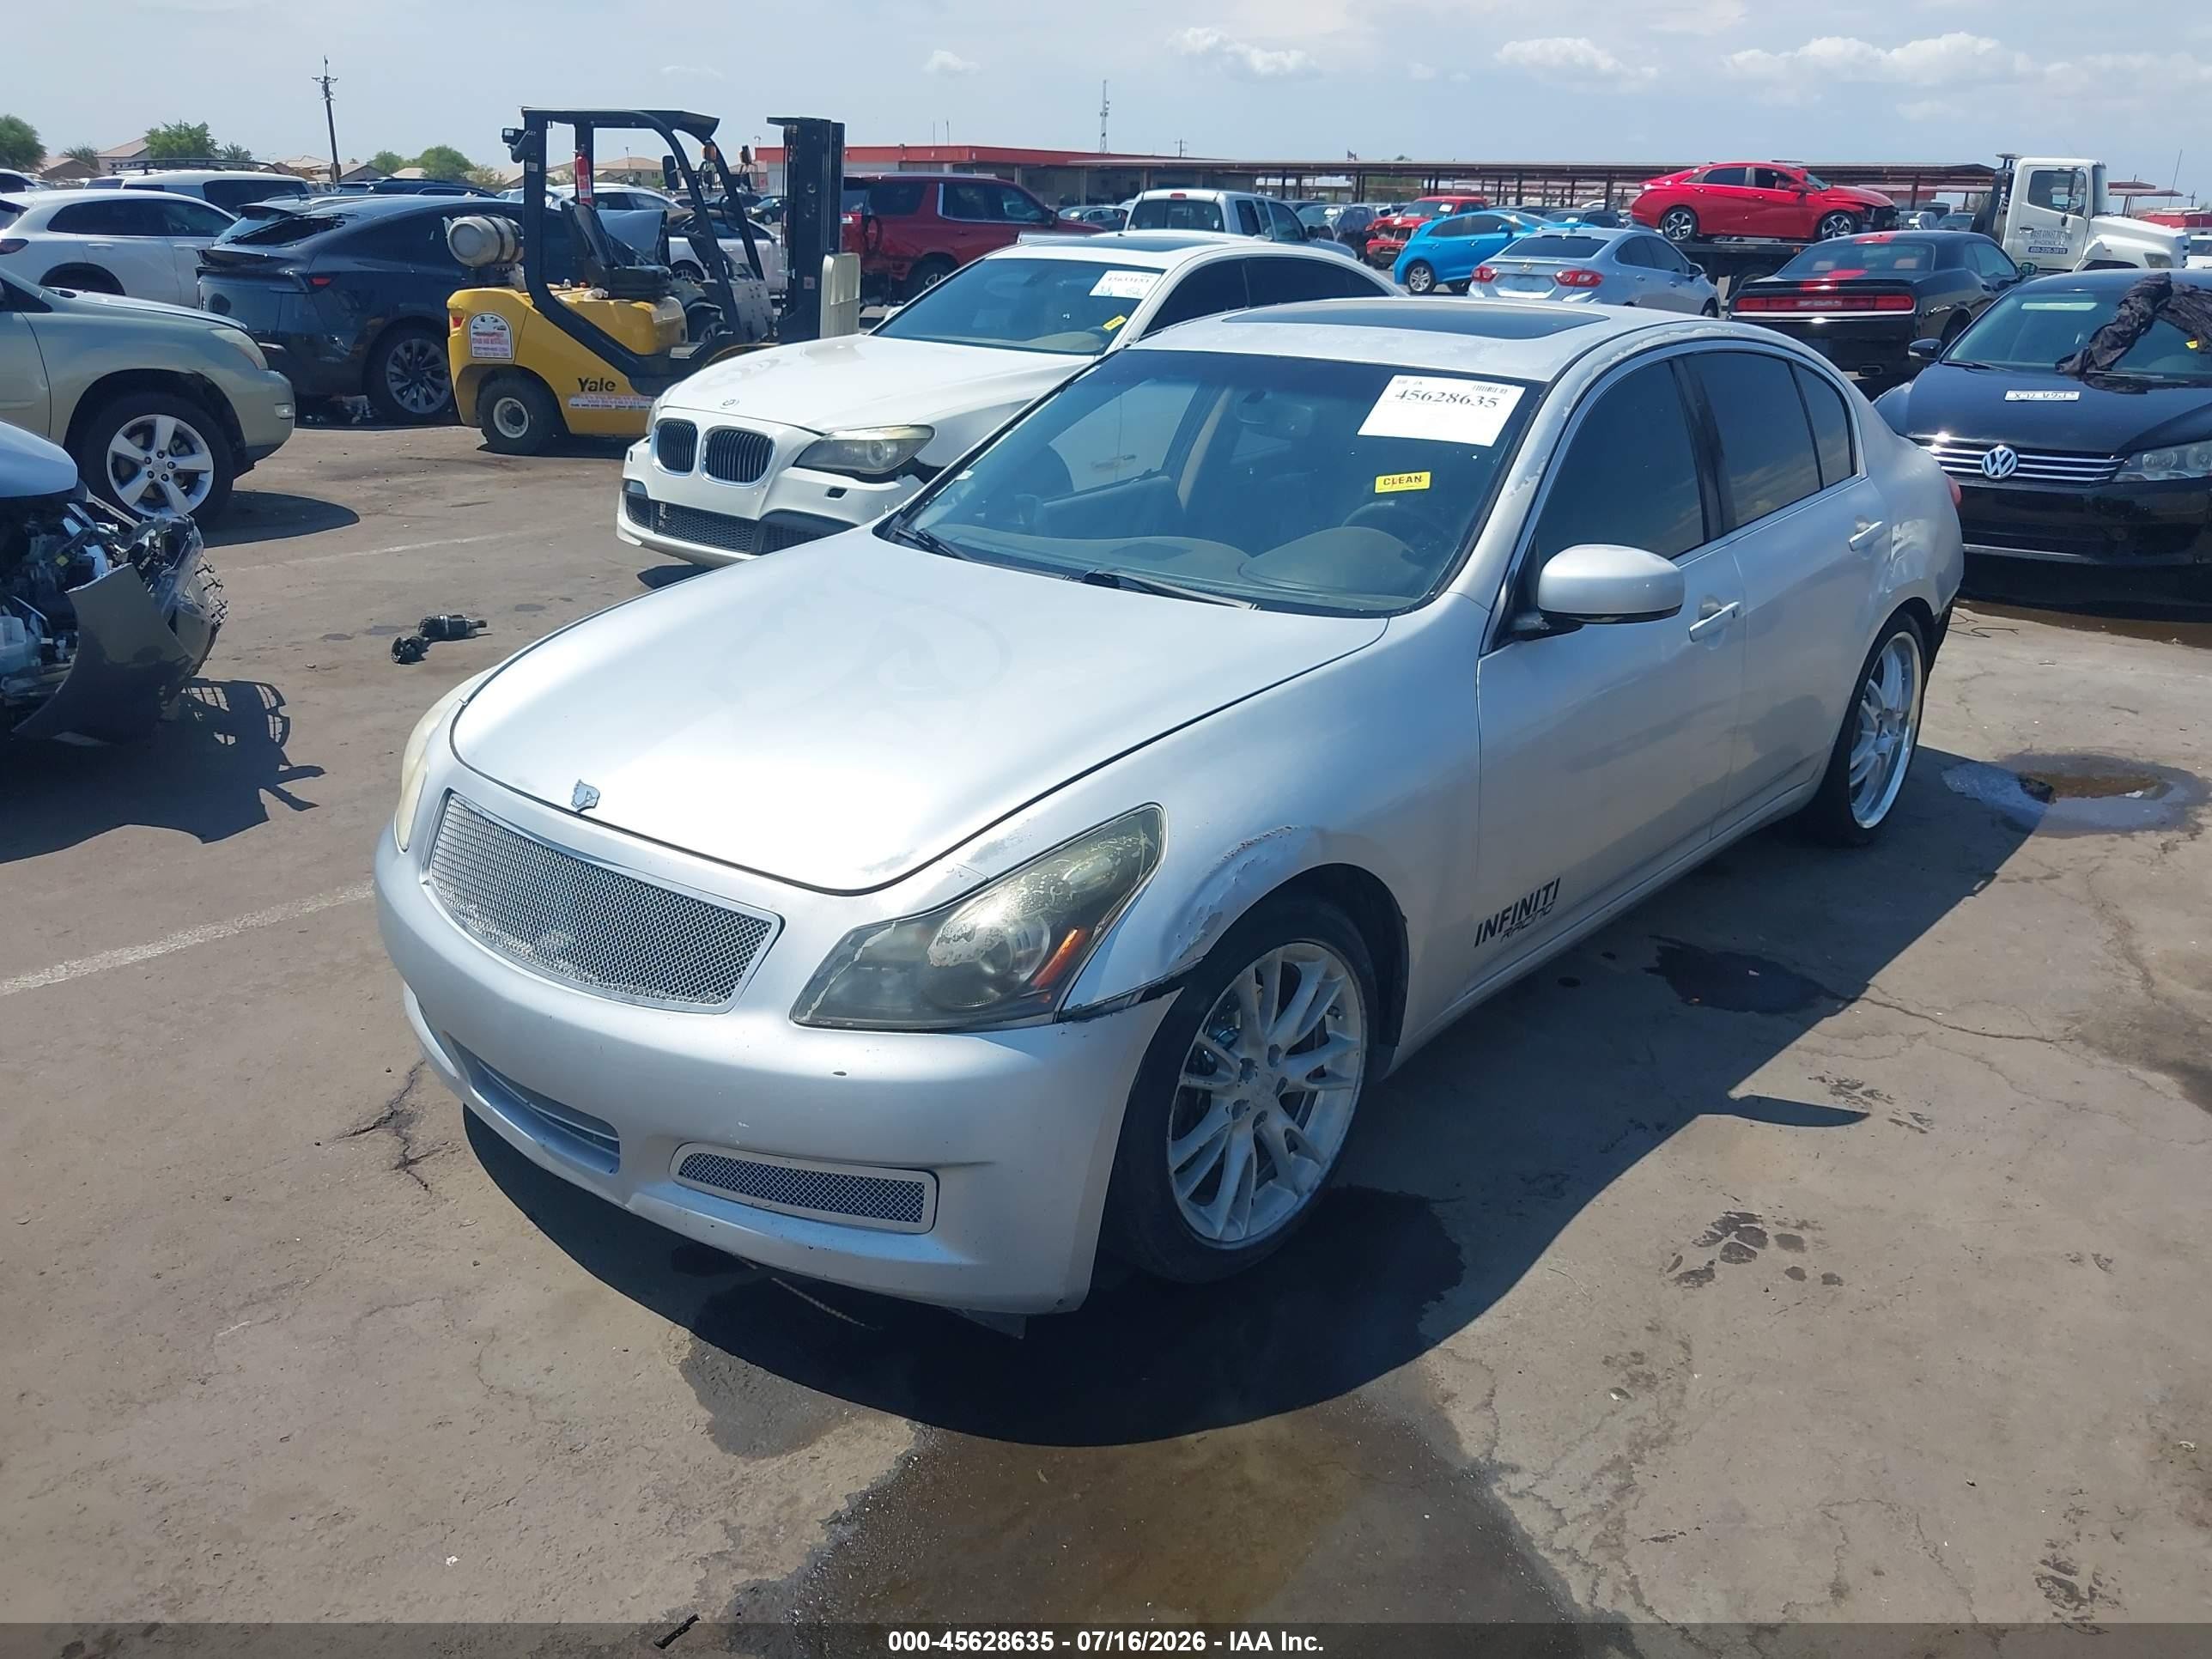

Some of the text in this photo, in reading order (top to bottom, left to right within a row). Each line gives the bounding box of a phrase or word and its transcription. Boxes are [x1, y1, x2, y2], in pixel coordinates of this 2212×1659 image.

[578, 378, 616, 392] Yale
[1395, 389, 1500, 409] 45628635
[1382, 475, 1423, 487] CLEAN
[1474, 877, 1560, 948] INFINITI
